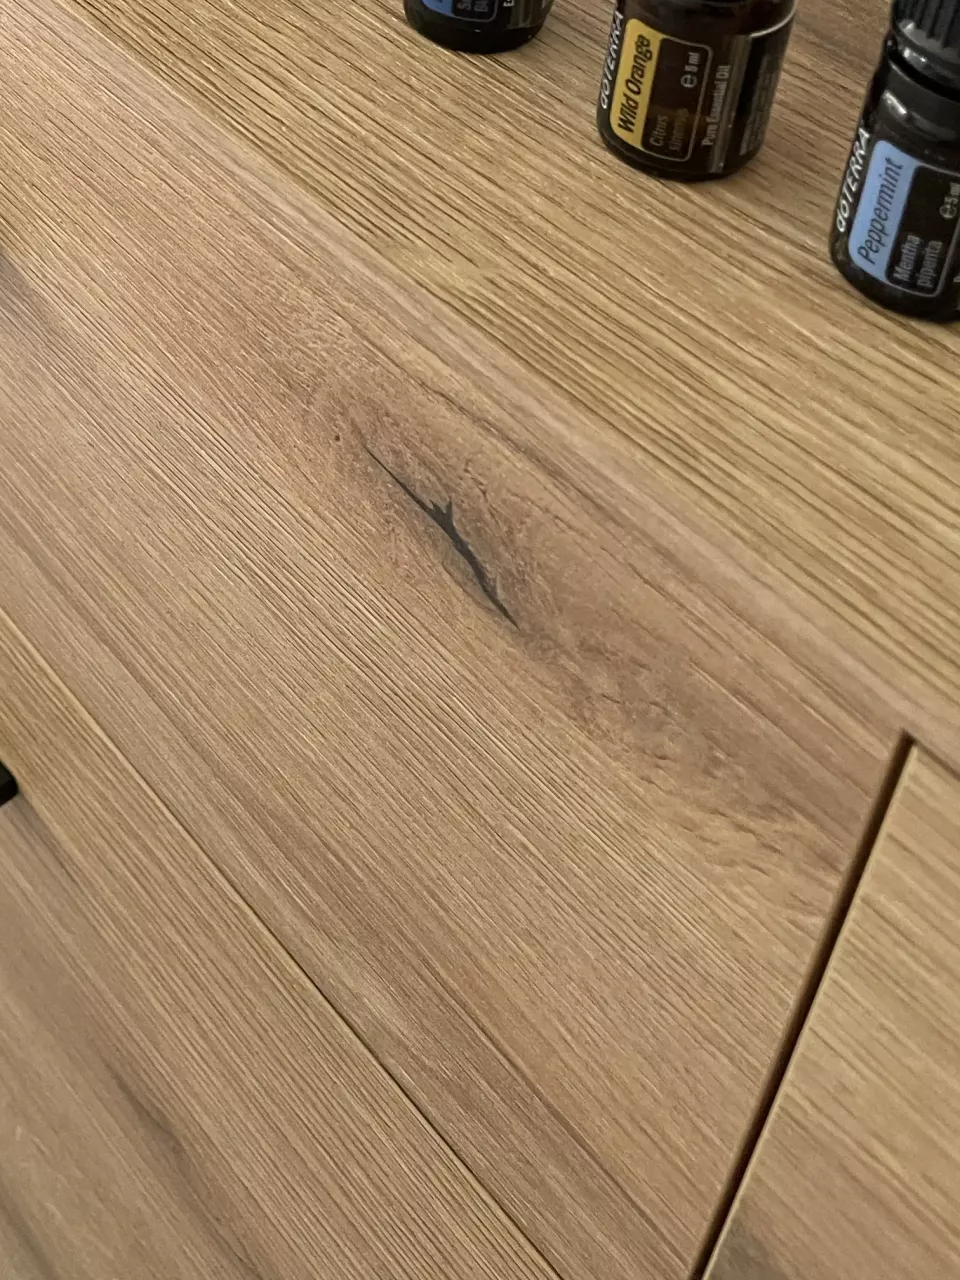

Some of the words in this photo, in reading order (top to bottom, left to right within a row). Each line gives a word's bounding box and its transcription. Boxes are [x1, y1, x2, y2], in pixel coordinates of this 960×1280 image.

[625, 34, 653, 96] Orange
[714, 64, 732, 80] Oil
[618, 94, 639, 134] Wild
[705, 80, 729, 123] Essential
[649, 114, 669, 147] Citrus
[700, 124, 720, 147] Pure
[857, 157, 904, 266] Peppermint
[893, 232, 922, 282] Mentha
